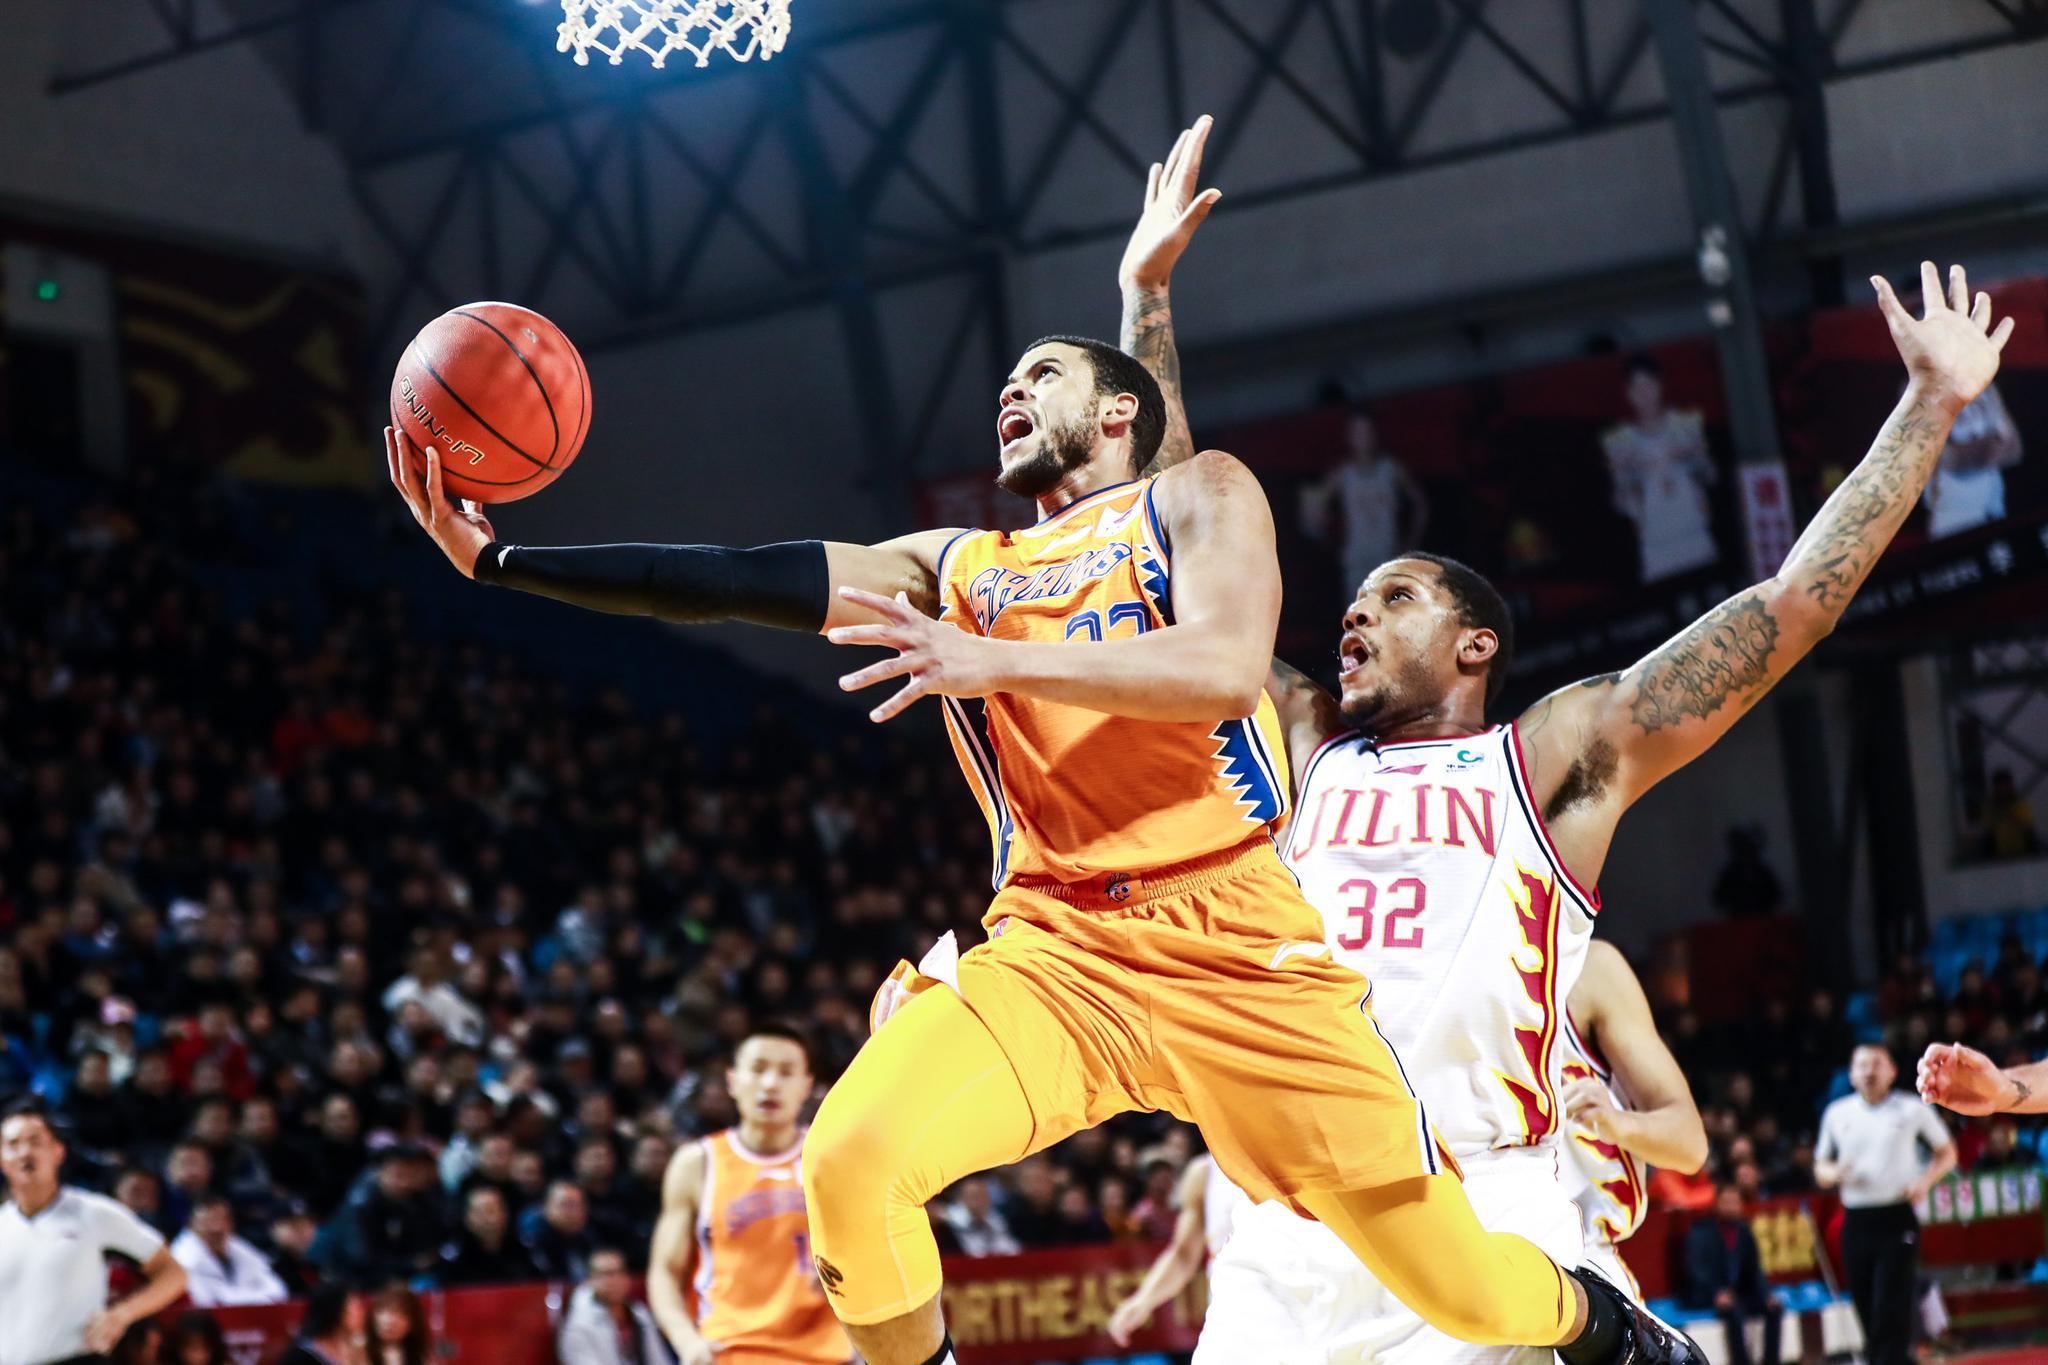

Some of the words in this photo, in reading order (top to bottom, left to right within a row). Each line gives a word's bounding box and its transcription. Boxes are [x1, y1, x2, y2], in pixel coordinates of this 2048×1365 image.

[399, 375, 486, 465] LI-NING
[1292, 784, 1496, 862] JILIN
[1337, 877, 1427, 951] 32
